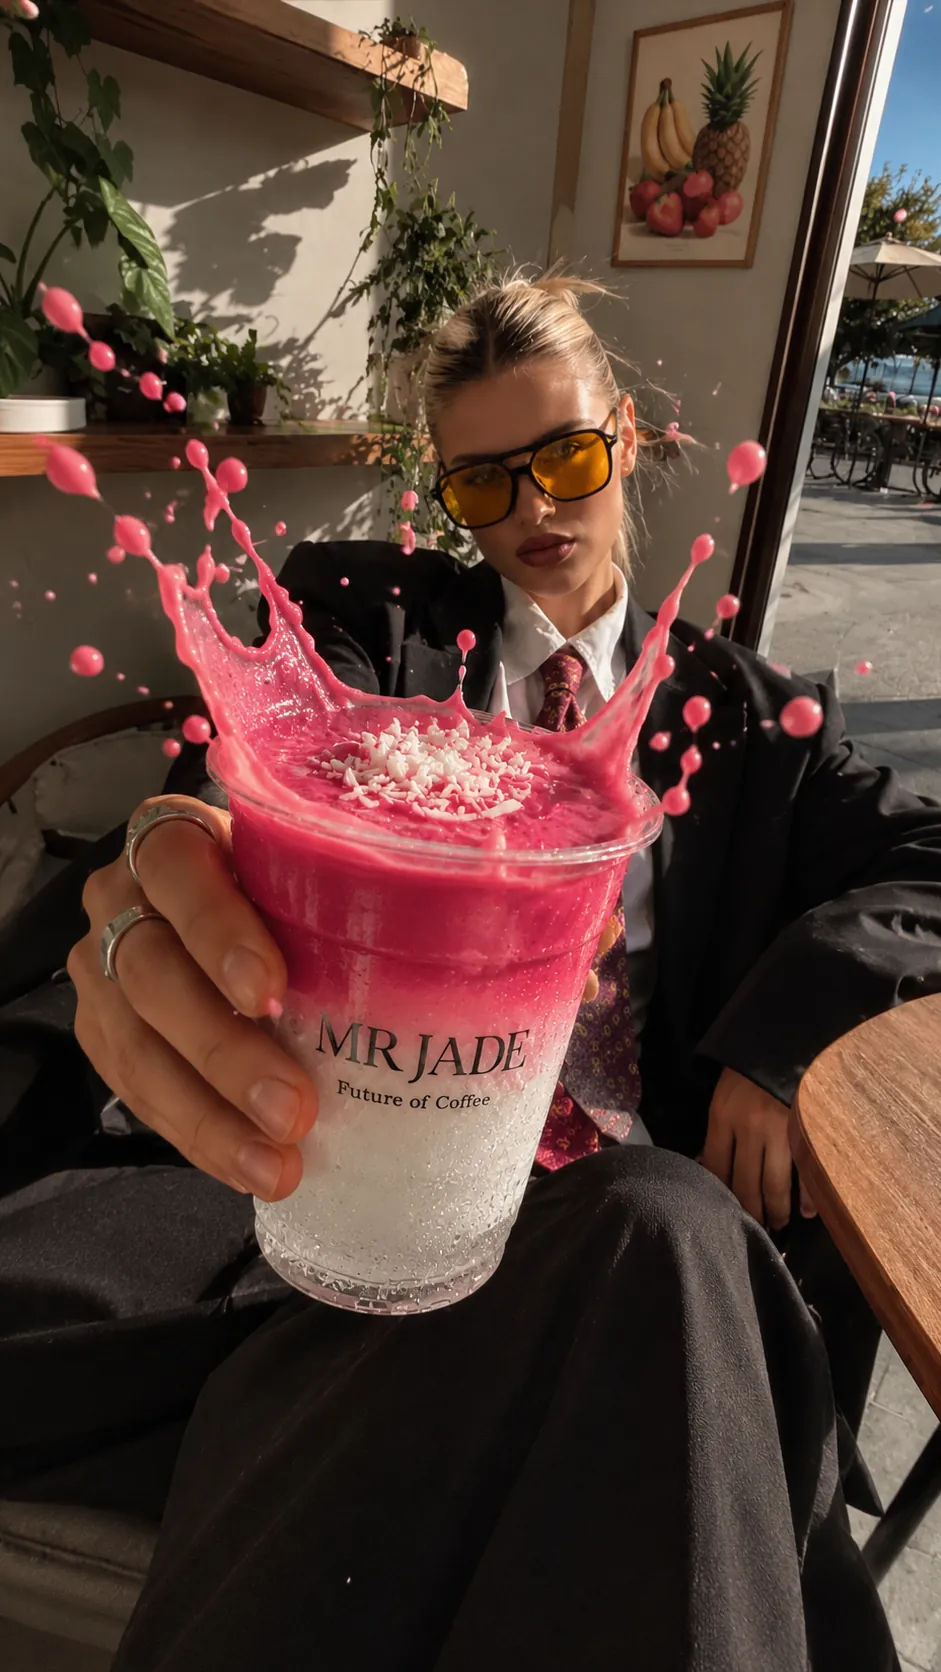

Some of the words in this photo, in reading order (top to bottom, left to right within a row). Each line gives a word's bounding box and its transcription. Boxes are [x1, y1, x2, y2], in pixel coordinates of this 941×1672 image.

[315, 1011, 404, 1073] MR
[408, 1029, 530, 1084] JADE
[336, 1079, 403, 1107] Future
[409, 1094, 431, 1110] of
[435, 1094, 491, 1110] Coffee
